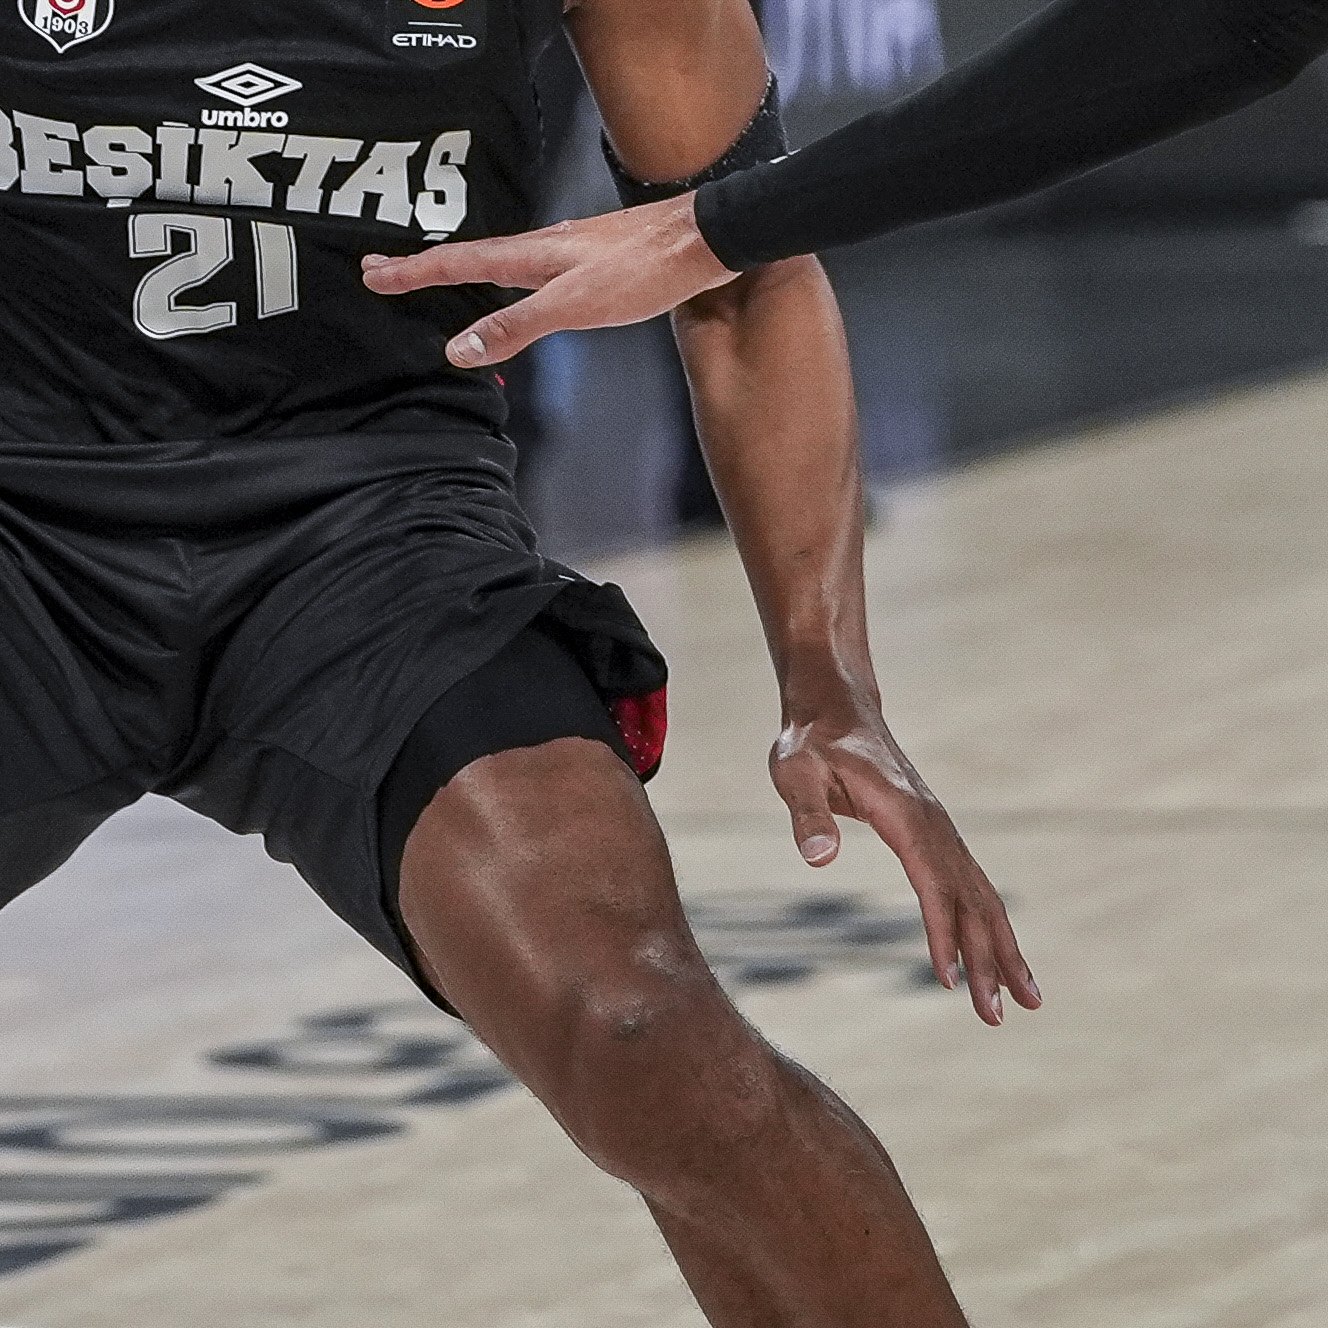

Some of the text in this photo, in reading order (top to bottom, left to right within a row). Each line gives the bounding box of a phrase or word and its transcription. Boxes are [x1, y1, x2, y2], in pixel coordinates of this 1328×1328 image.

[41, 15, 89, 35] 1903
[392, 32, 477, 49] ETIHAD
[201, 107, 289, 128] umbro
[127, 212, 300, 341] 21
